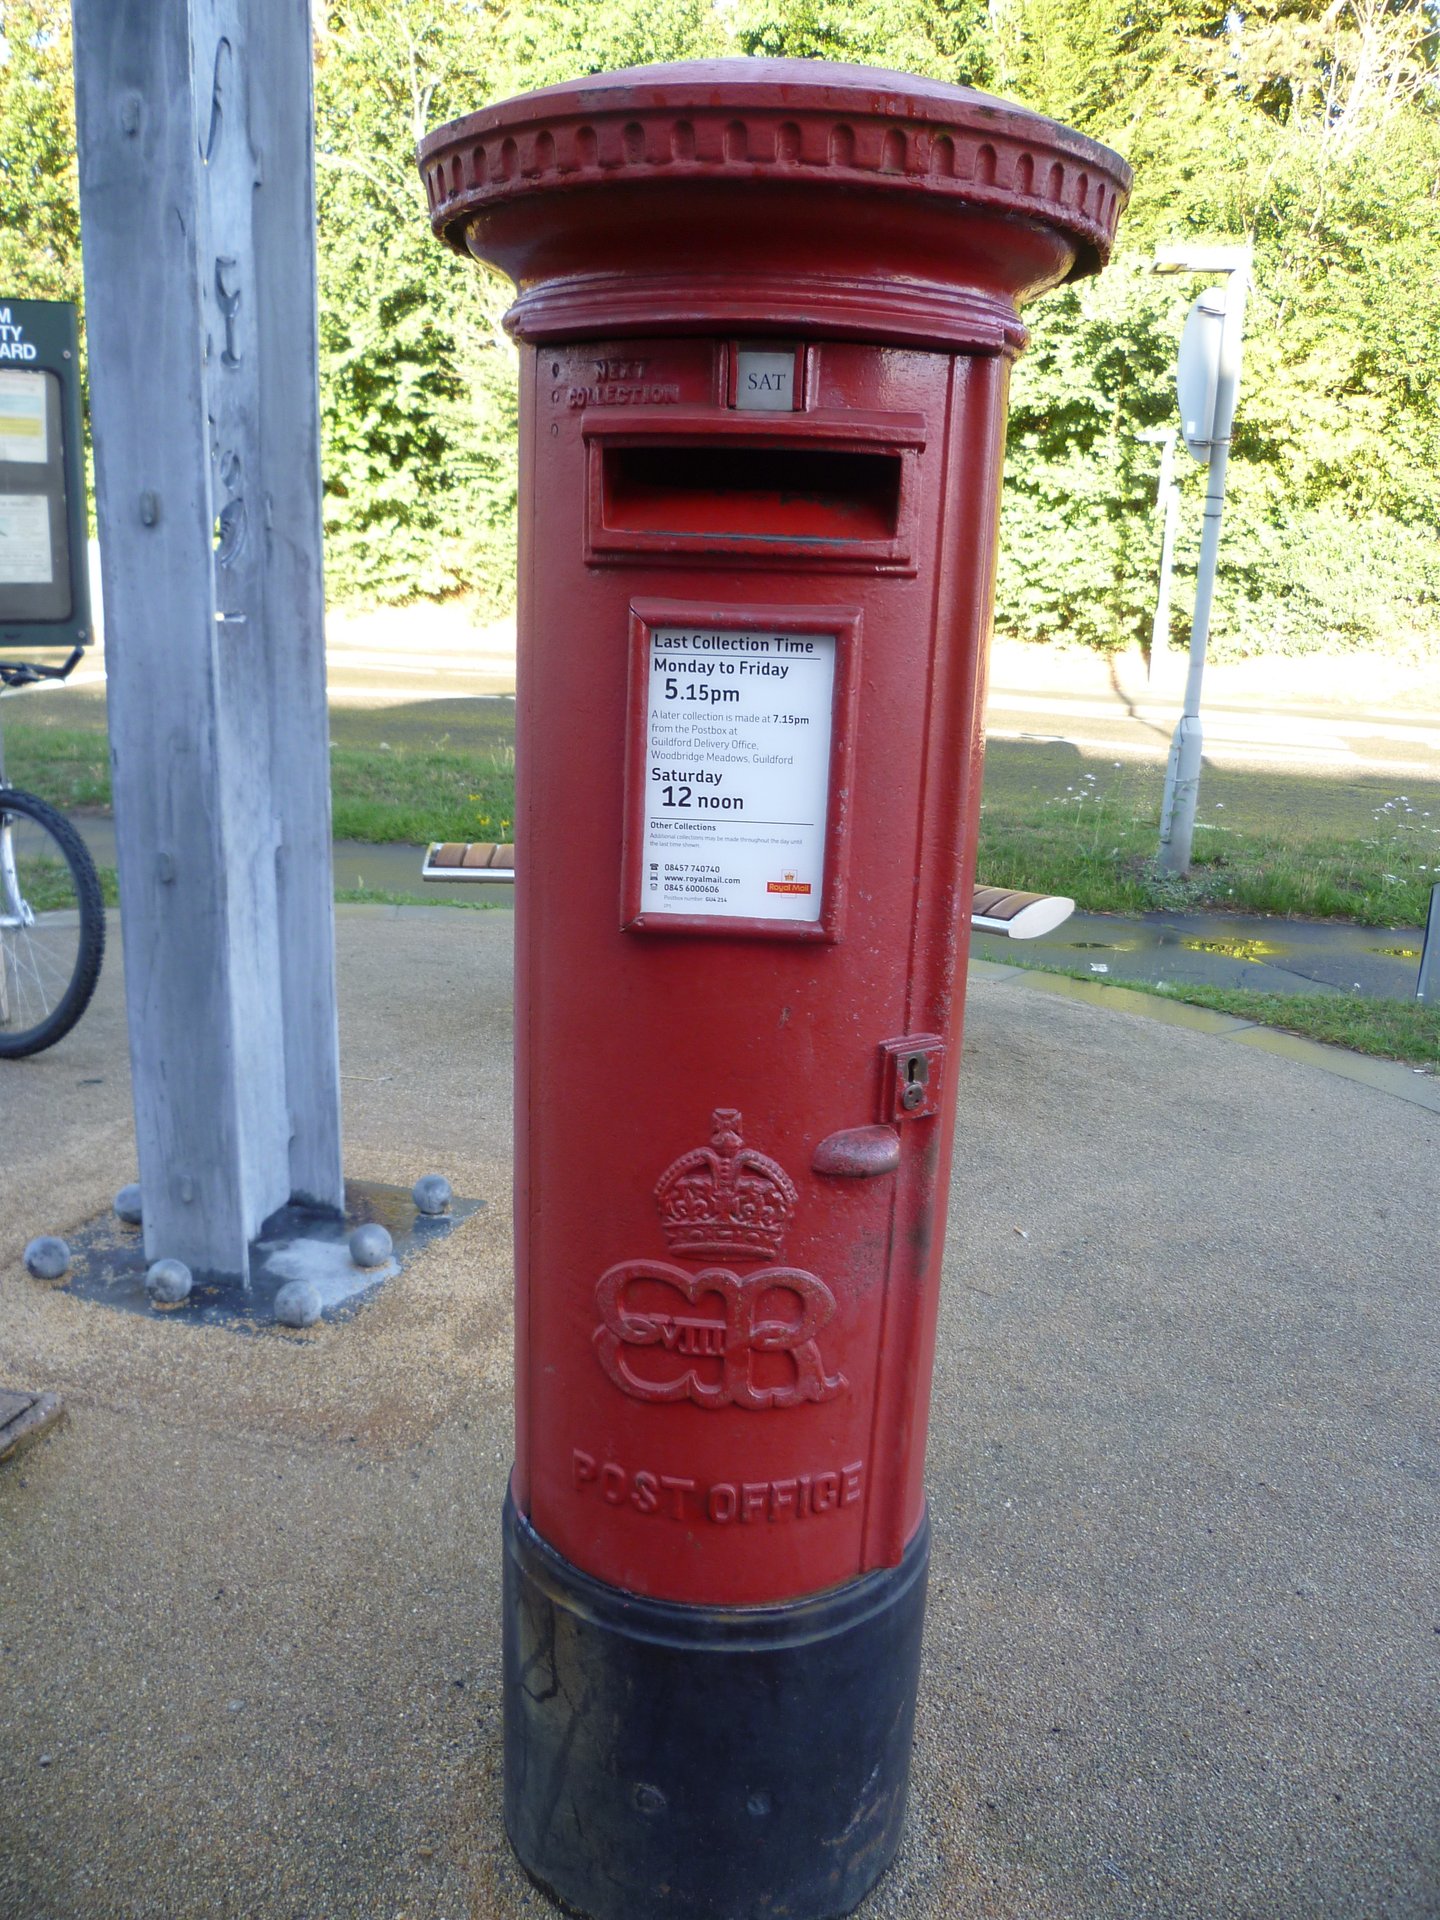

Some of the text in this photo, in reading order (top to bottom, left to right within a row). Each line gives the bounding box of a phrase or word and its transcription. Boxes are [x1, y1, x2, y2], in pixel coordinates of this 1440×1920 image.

[596, 360, 646, 382] NEXT
[748, 373, 786, 391] SAT
[568, 384, 680, 408] COLLECTION
[654, 634, 814, 653] Last Collection Time
[654, 658, 789, 679] Monday to Friday
[665, 678, 740, 705] 5.15pm
[651, 710, 810, 726] A later collection is made at 7.15pm
[651, 724, 738, 735] from the Postbox at
[651, 737, 759, 750] Guildford Delivery Office,
[651, 750, 793, 765] Woodbridge Meadows, Guildford
[651, 768, 723, 786] Saturday
[662, 785, 744, 810] 12 noon
[650, 821, 717, 832] Other Collections
[664, 863, 720, 873] 08457 740740
[664, 875, 741, 884] www.royalmail.com
[768, 883, 810, 893] Royal Mail
[664, 884, 720, 893] 0845 6000606
[572, 1447, 863, 1524] POST OFFICE
